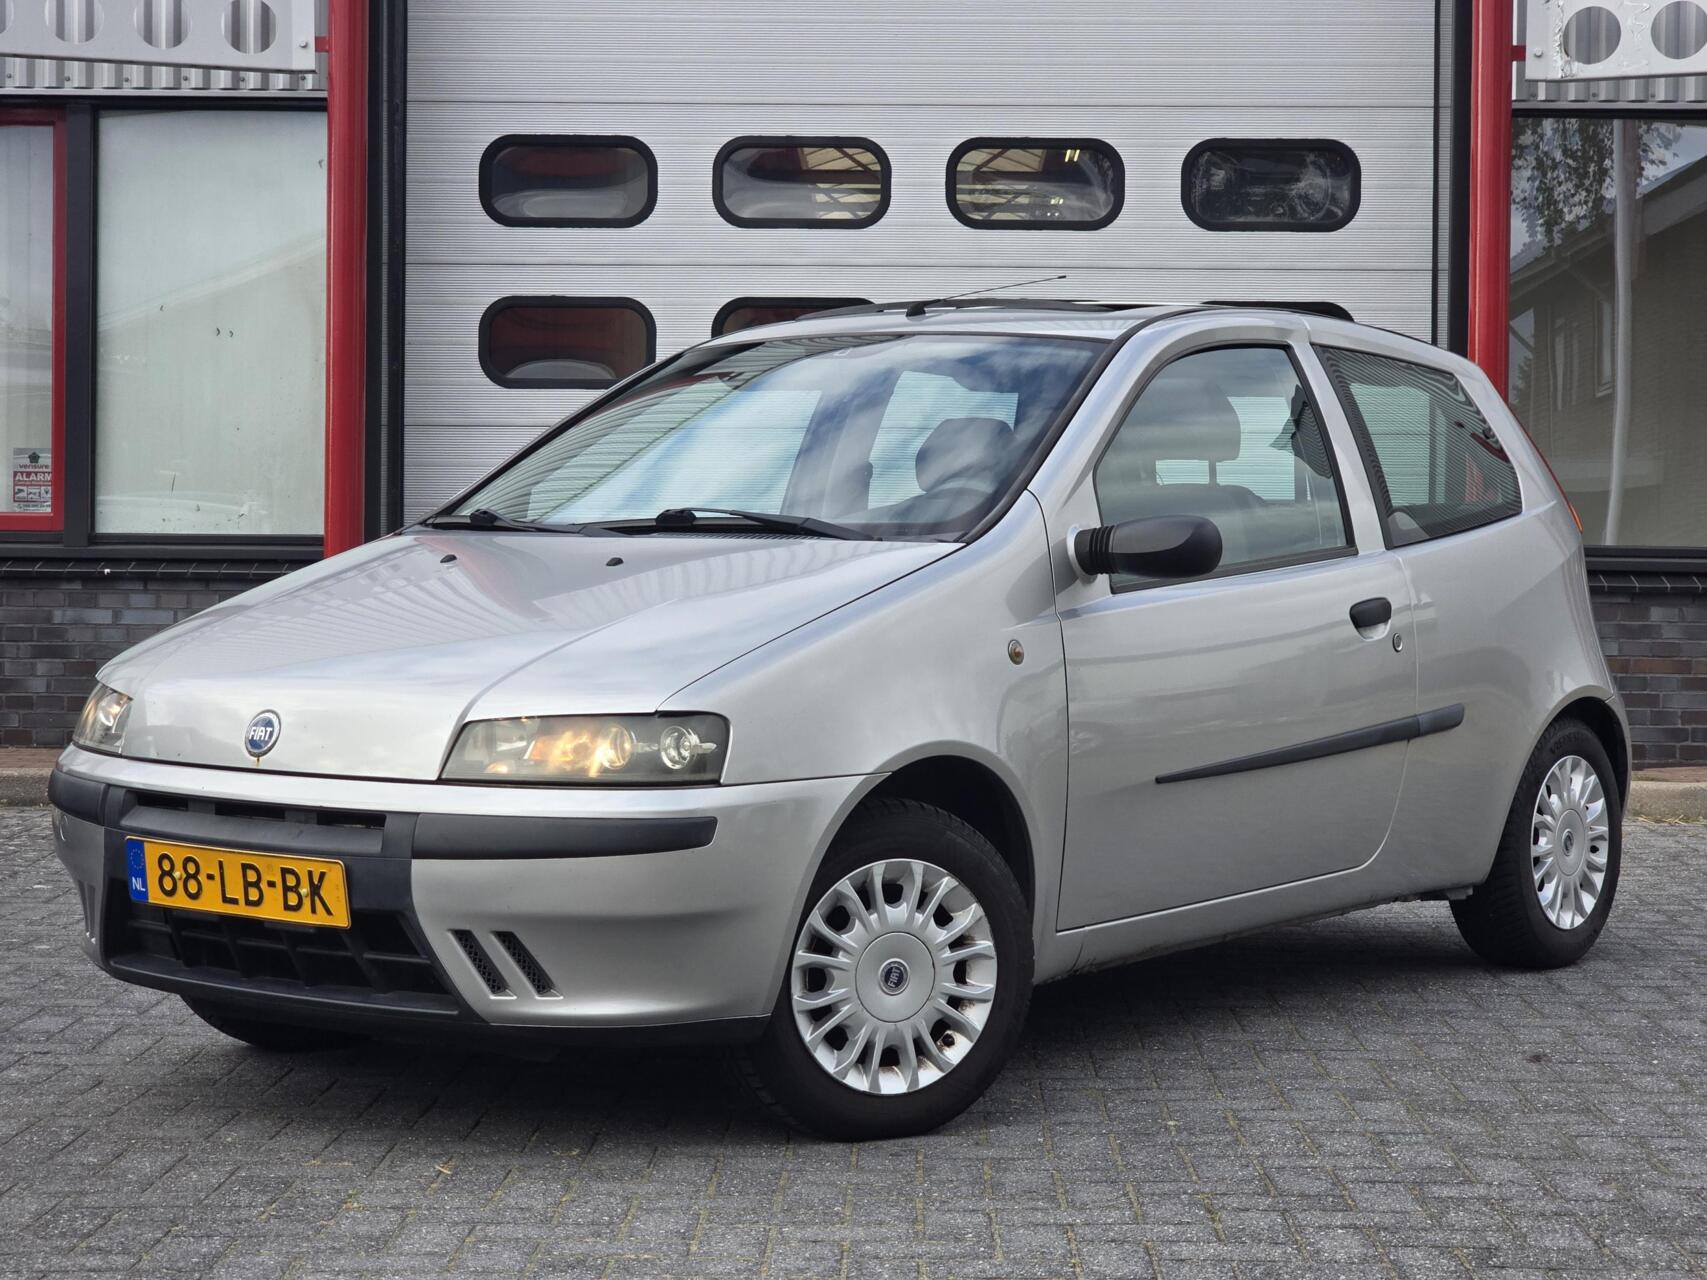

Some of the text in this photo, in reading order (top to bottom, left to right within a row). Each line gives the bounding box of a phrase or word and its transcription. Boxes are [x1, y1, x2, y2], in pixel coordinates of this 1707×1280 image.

[15, 472, 51, 480] ALARM
[249, 726, 273, 741] FIAT
[132, 876, 146, 892] NL
[157, 852, 334, 916] 88-LB-BK
[887, 967, 901, 988] FIAT
